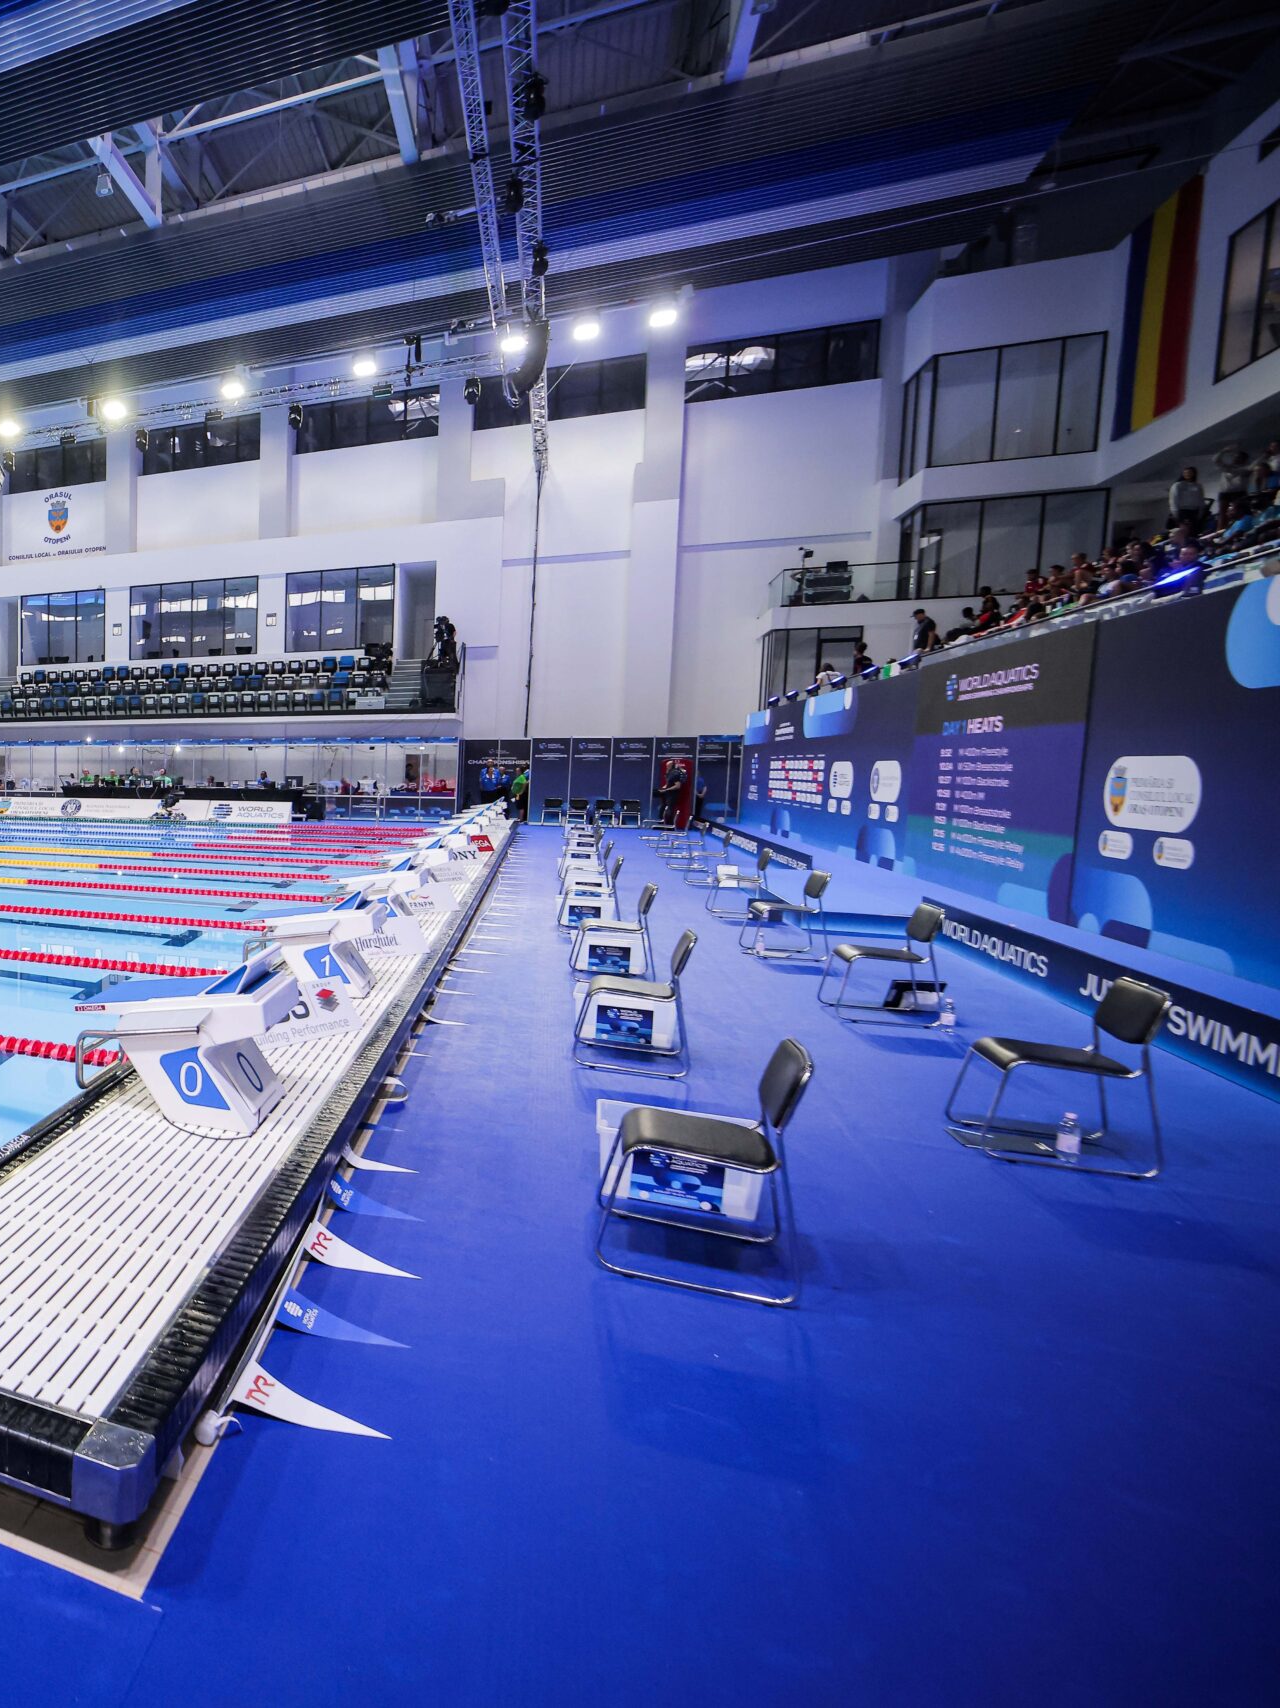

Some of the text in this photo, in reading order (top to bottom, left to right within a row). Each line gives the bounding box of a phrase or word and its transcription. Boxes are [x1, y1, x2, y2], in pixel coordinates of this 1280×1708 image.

[45, 492, 72, 503] ORASUL
[44, 534, 71, 544] OTOPENI
[959, 664, 1039, 691] WORLD AQUATICS
[967, 716, 1003, 734] HEATS
[355, 934, 398, 952] Harghitei
[942, 919, 1048, 977] WORLD AQUATICS
[320, 955, 330, 976] 1
[256, 1018, 350, 1045] uilding Performance
[180, 1061, 202, 1096] 0
[236, 1052, 263, 1092] 0
[310, 1232, 333, 1256] TYR
[245, 1375, 275, 1405] TYR
